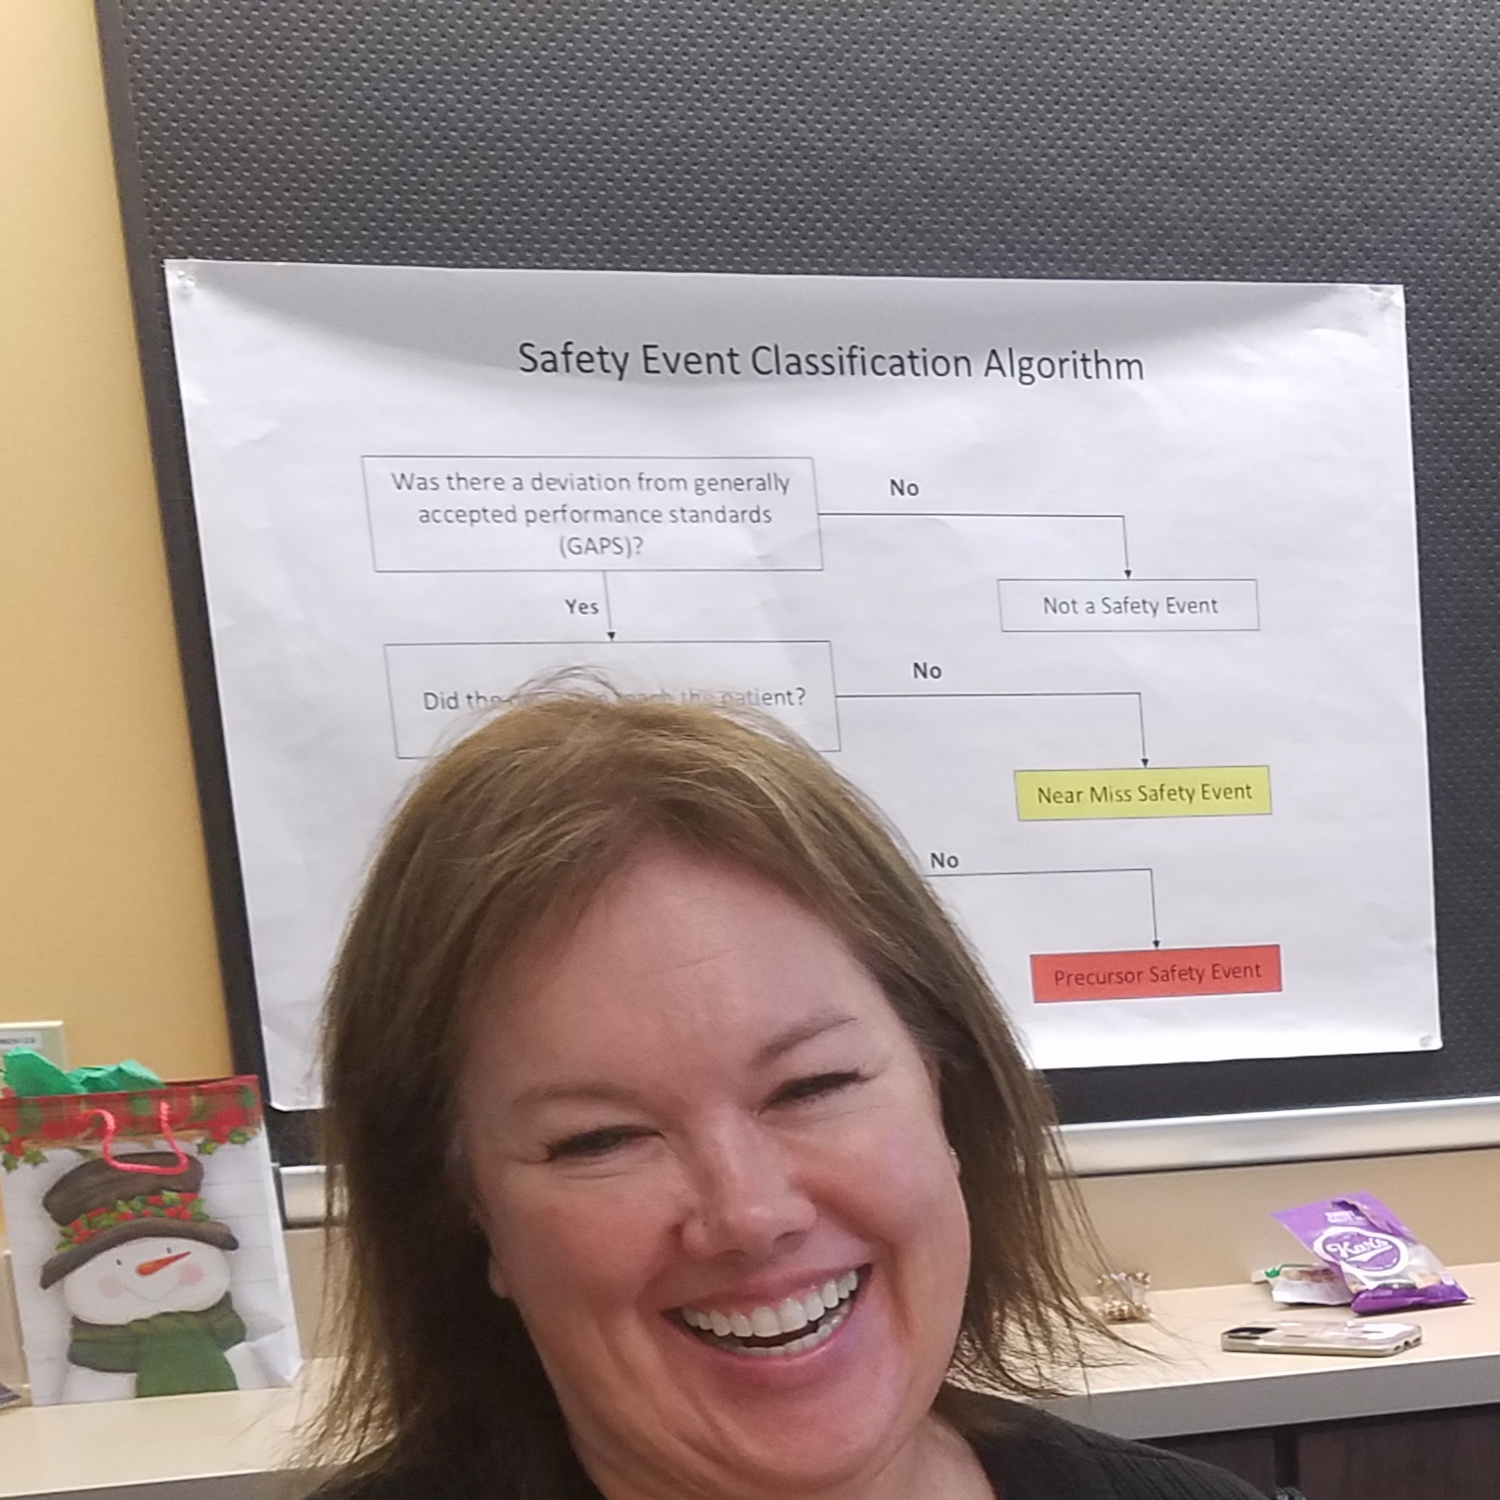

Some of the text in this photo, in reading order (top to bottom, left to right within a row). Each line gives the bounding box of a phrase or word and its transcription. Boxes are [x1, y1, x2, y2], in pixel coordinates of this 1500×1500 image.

[519, 341, 1145, 386] Safety Event Classification Algorithm
[391, 471, 791, 496] Was there a deviation from generally
[890, 479, 920, 497] No
[418, 505, 773, 528] accepted performance standards
[559, 535, 644, 559] (GAPS)?
[565, 598, 599, 615] Yes
[1043, 596, 1219, 618] Not a Safety Event
[913, 662, 942, 680] No
[424, 691, 460, 711] Did
[1038, 783, 1253, 806] Near Miss Safety Event
[930, 852, 960, 869] No
[1054, 962, 1262, 986] Precursor Safety Event
